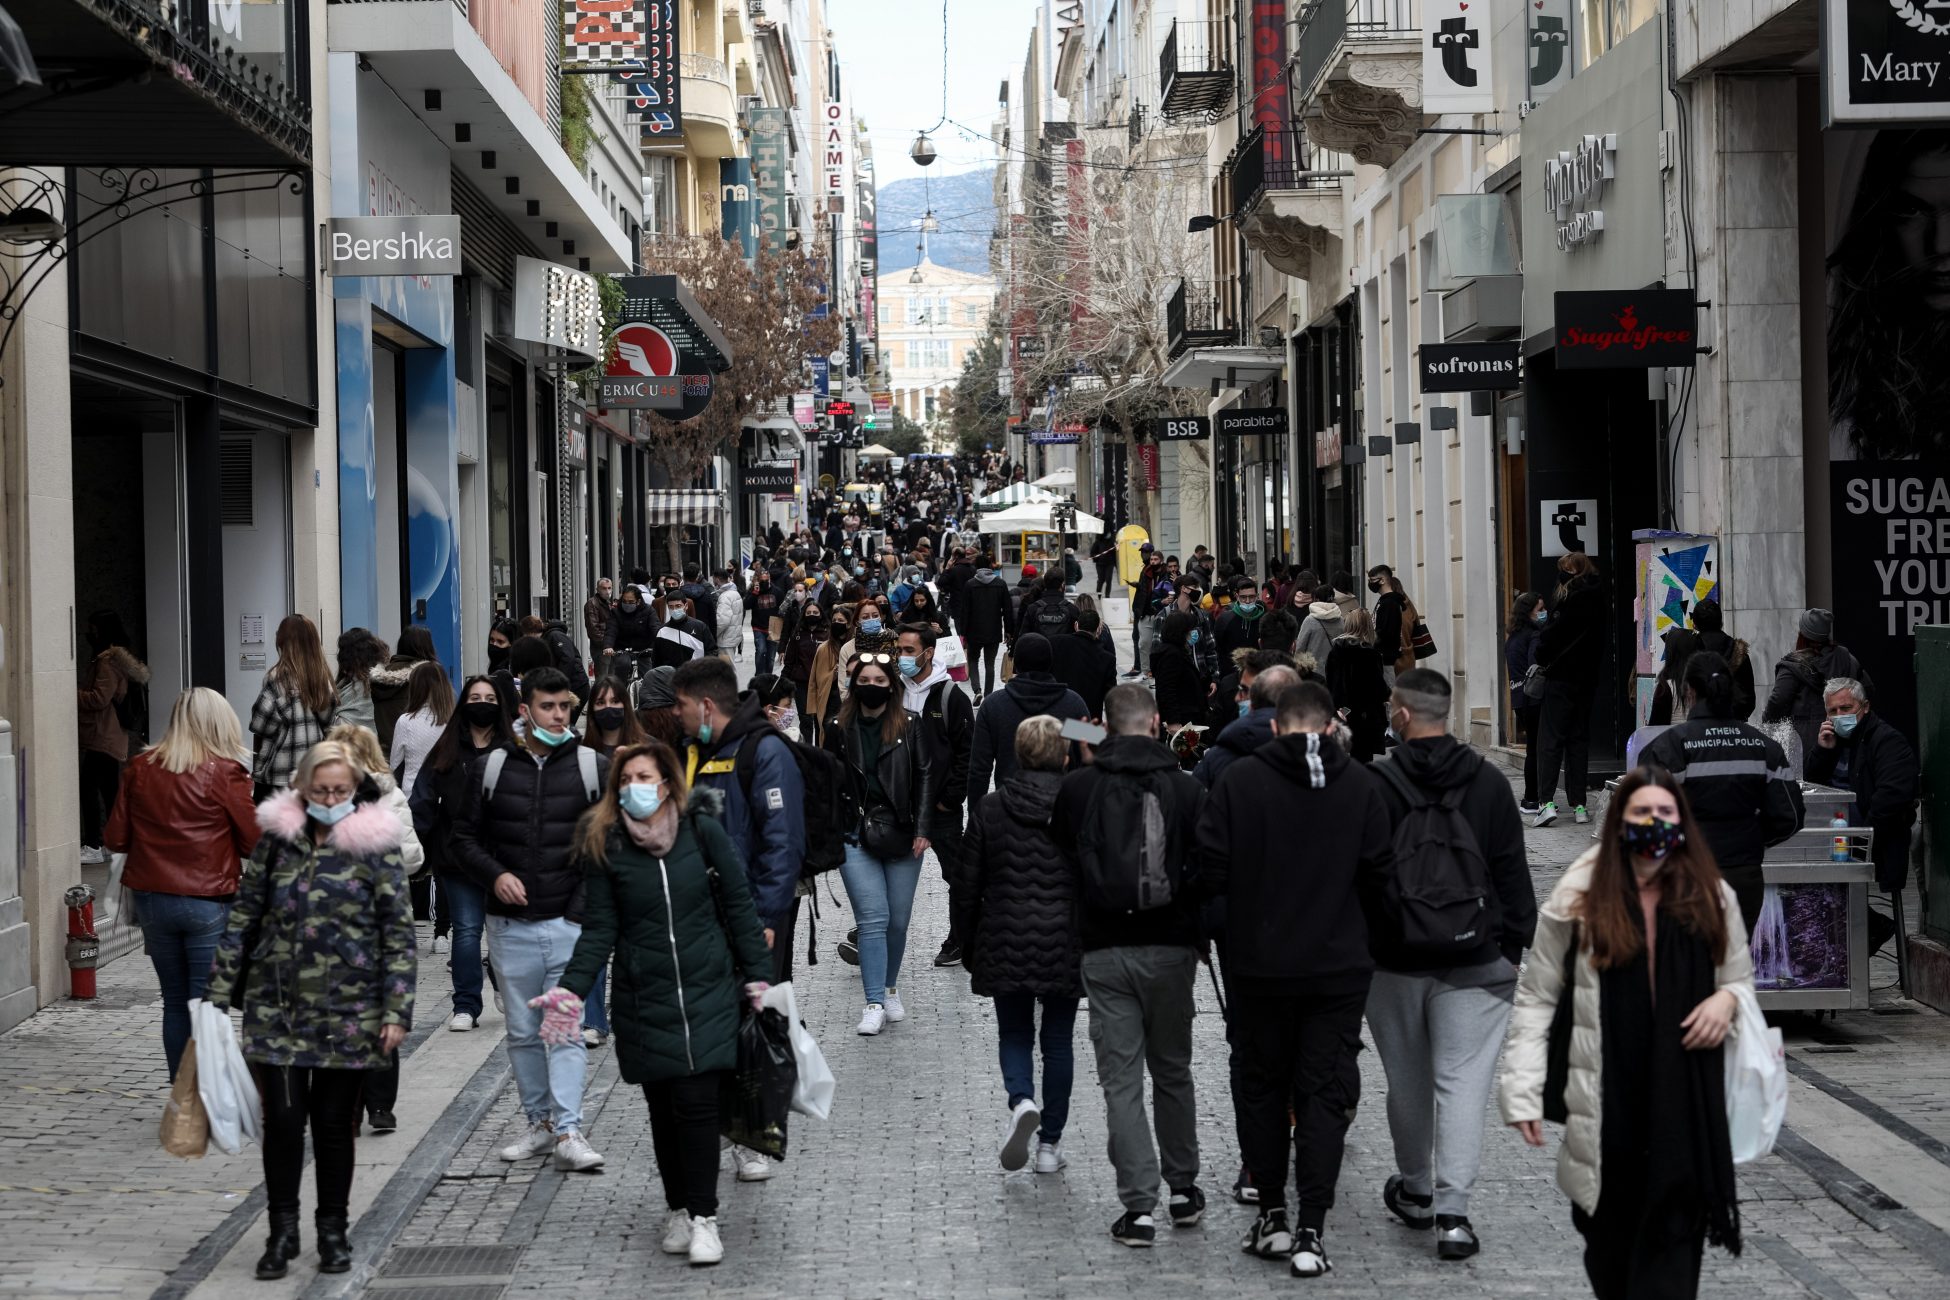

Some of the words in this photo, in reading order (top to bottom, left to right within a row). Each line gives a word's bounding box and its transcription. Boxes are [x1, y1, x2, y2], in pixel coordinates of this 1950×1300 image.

[1861, 53, 1941, 88] Mary
[332, 231, 453, 261] Bershka
[1560, 326, 1694, 351] Sugarfree
[1428, 356, 1514, 374] sofronas
[661, 385, 677, 398] 46
[1167, 421, 1200, 437] BSB
[1223, 416, 1275, 430] parabita
[745, 476, 793, 486] ROMANO
[1705, 727, 1741, 736] ATHENS
[1684, 739, 1734, 749] MUNICIPAL
